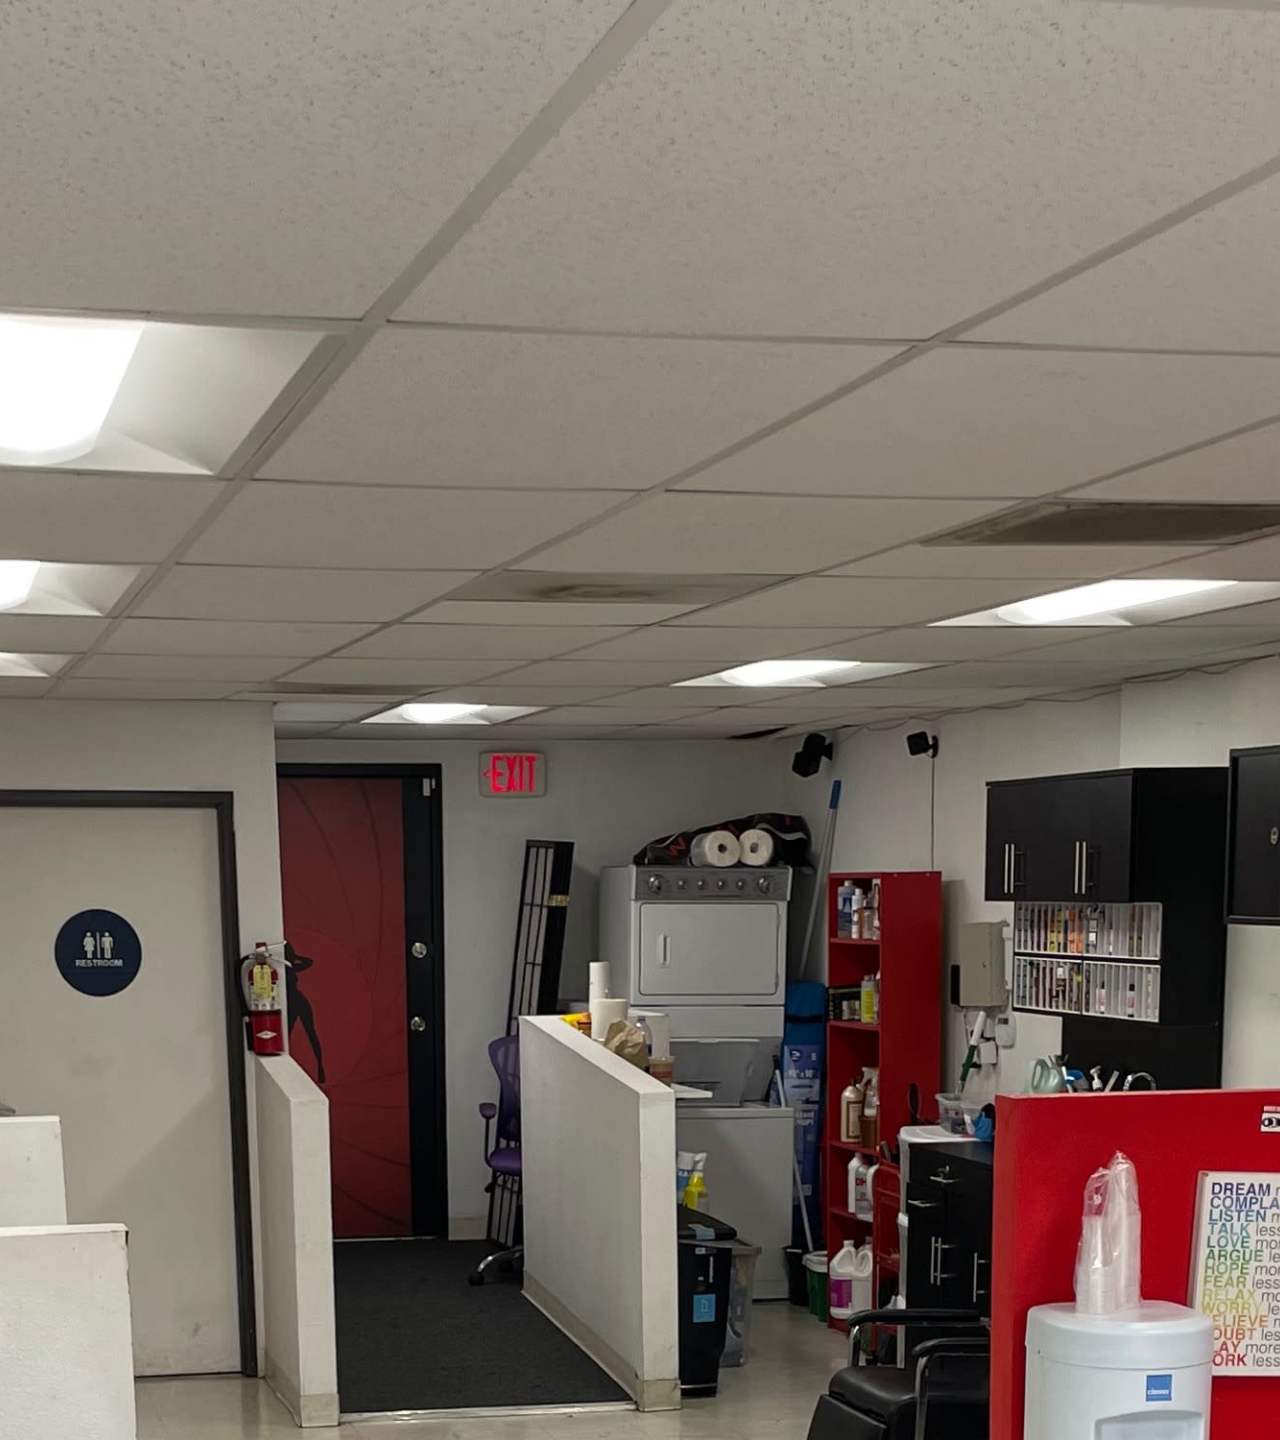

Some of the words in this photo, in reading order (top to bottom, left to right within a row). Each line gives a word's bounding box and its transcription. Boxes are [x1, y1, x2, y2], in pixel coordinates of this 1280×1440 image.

[491, 754, 537, 793] EXIT
[75, 959, 124, 968] RESTROOM
[1211, 1182, 1270, 1196] DREAM
[1209, 1210, 1267, 1222] LISTEN
[1208, 1222, 1250, 1236] TALK
[1207, 1236, 1250, 1248] LOVE
[1205, 1250, 1264, 1262] ARGUE
[1205, 1263, 1250, 1275] HOPE
[1204, 1276, 1247, 1288] FEAR
[1252, 1277, 1280, 1289] less
[1203, 1289, 1256, 1301] RELAX
[1201, 1301, 1264, 1314] WORRY
[1212, 1315, 1269, 1328] ELIEVE
[1213, 1328, 1257, 1341] OUBT
[1214, 1340, 1241, 1353] AY
[1212, 1353, 1248, 1367] ORK
[1252, 1355, 1280, 1367] less
